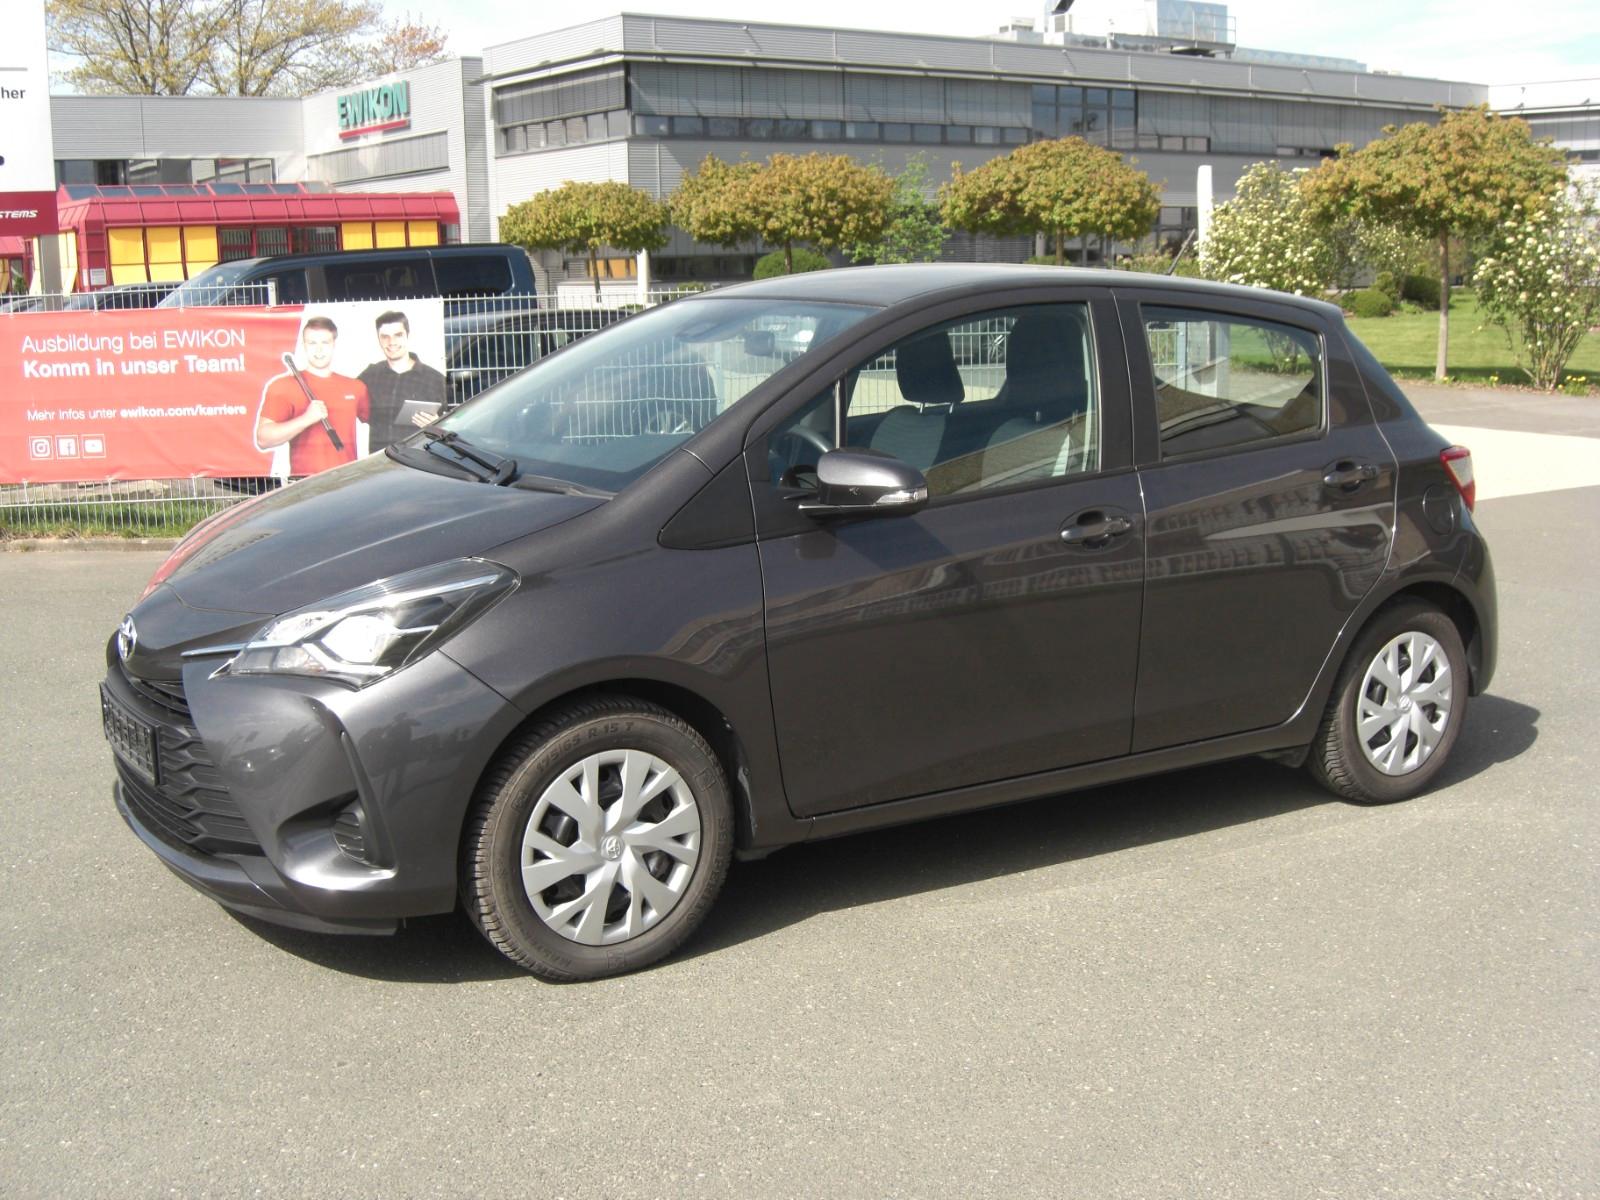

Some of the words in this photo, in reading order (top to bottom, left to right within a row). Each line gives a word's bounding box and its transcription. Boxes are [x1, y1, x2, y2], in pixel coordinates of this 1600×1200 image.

[337, 80, 408, 128] EWIKON
[22, 333, 124, 354] Ausbildung
[130, 332, 157, 349] bei
[163, 328, 245, 348] EWIKON
[23, 359, 90, 378] Komm
[96, 358, 115, 376] in
[121, 358, 178, 375] unser
[184, 353, 246, 373] Team!
[26, 409, 55, 422] Mehr
[59, 408, 86, 421] Infos
[89, 408, 117, 420] unter
[119, 404, 248, 419] ewikon.com/karriere
